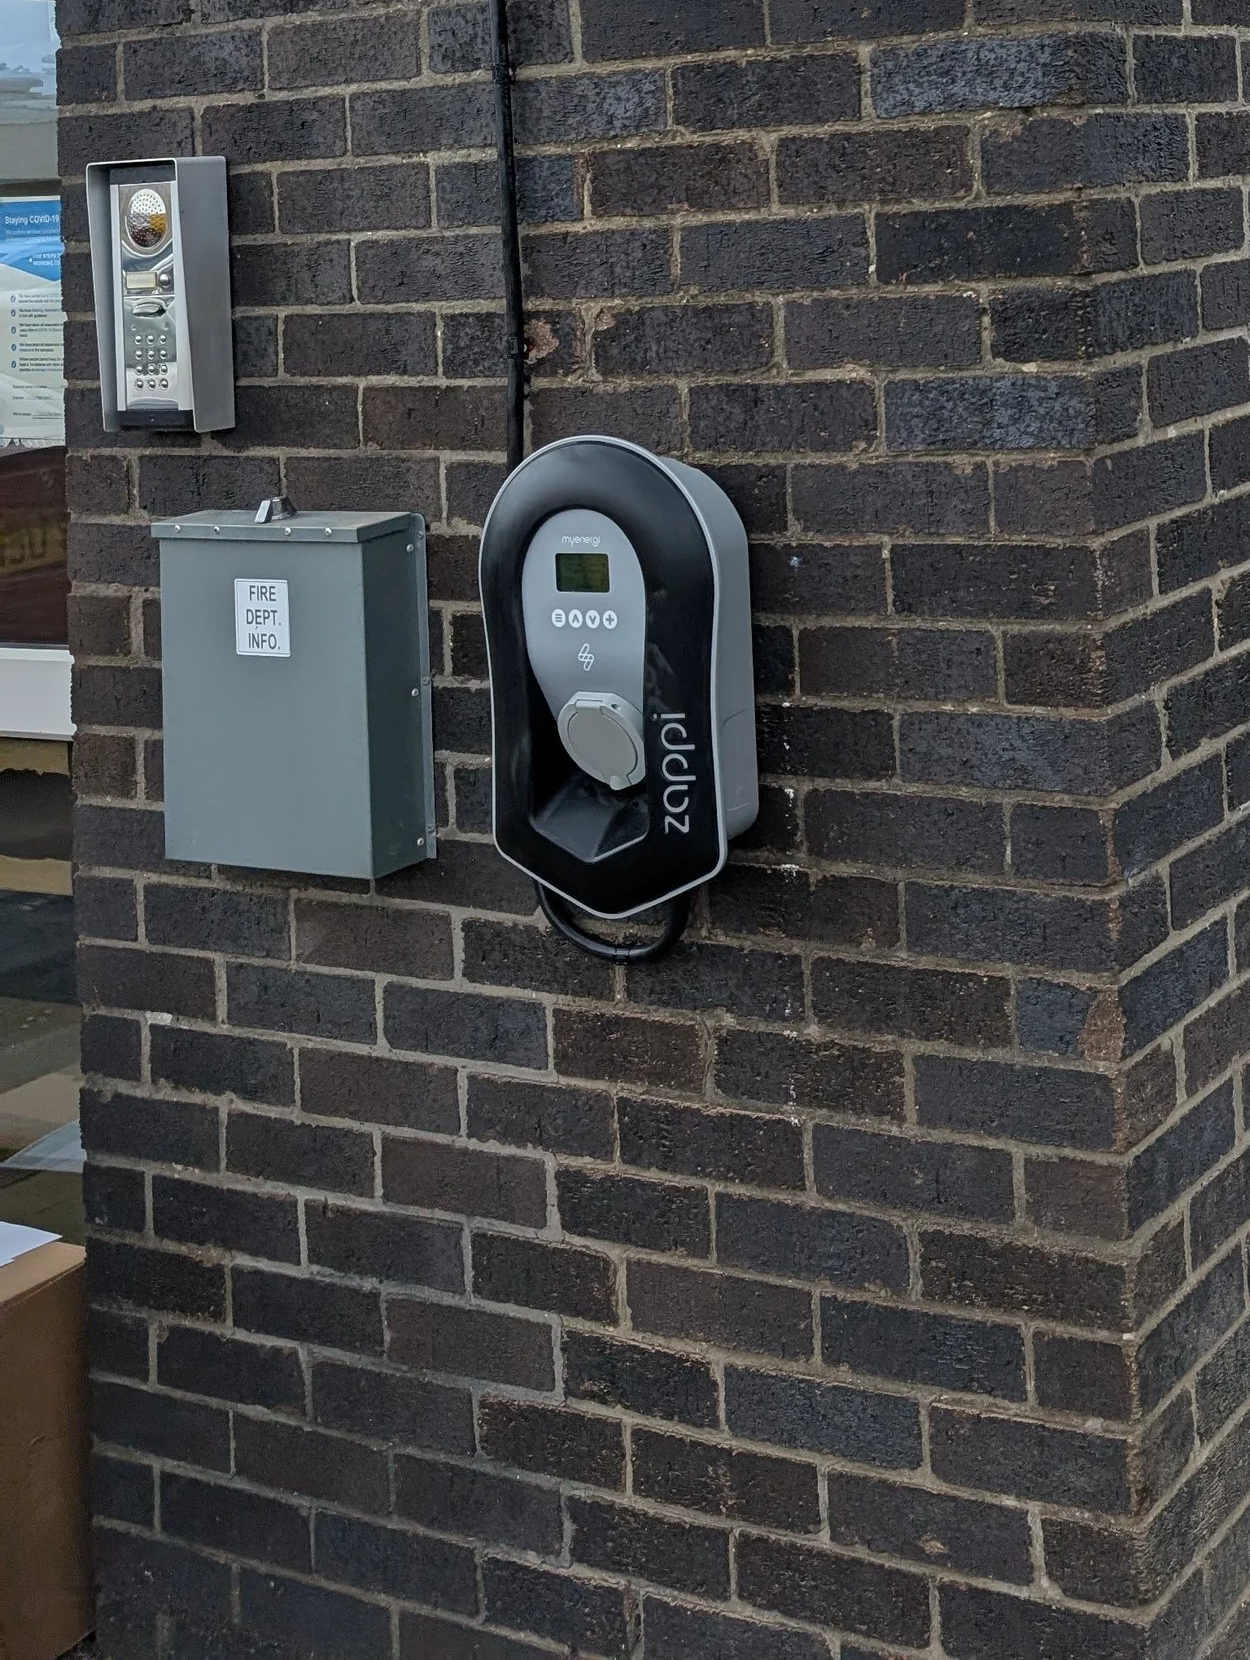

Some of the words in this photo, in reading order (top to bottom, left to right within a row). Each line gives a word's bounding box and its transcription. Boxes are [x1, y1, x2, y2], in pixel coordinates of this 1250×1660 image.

[5, 216, 28, 226] Staying
[561, 535, 601, 547] myenergi
[249, 585, 277, 602] FIRE
[246, 609, 281, 626] DEPT.
[248, 633, 280, 650] INFO.
[653, 713, 696, 834] zappi
